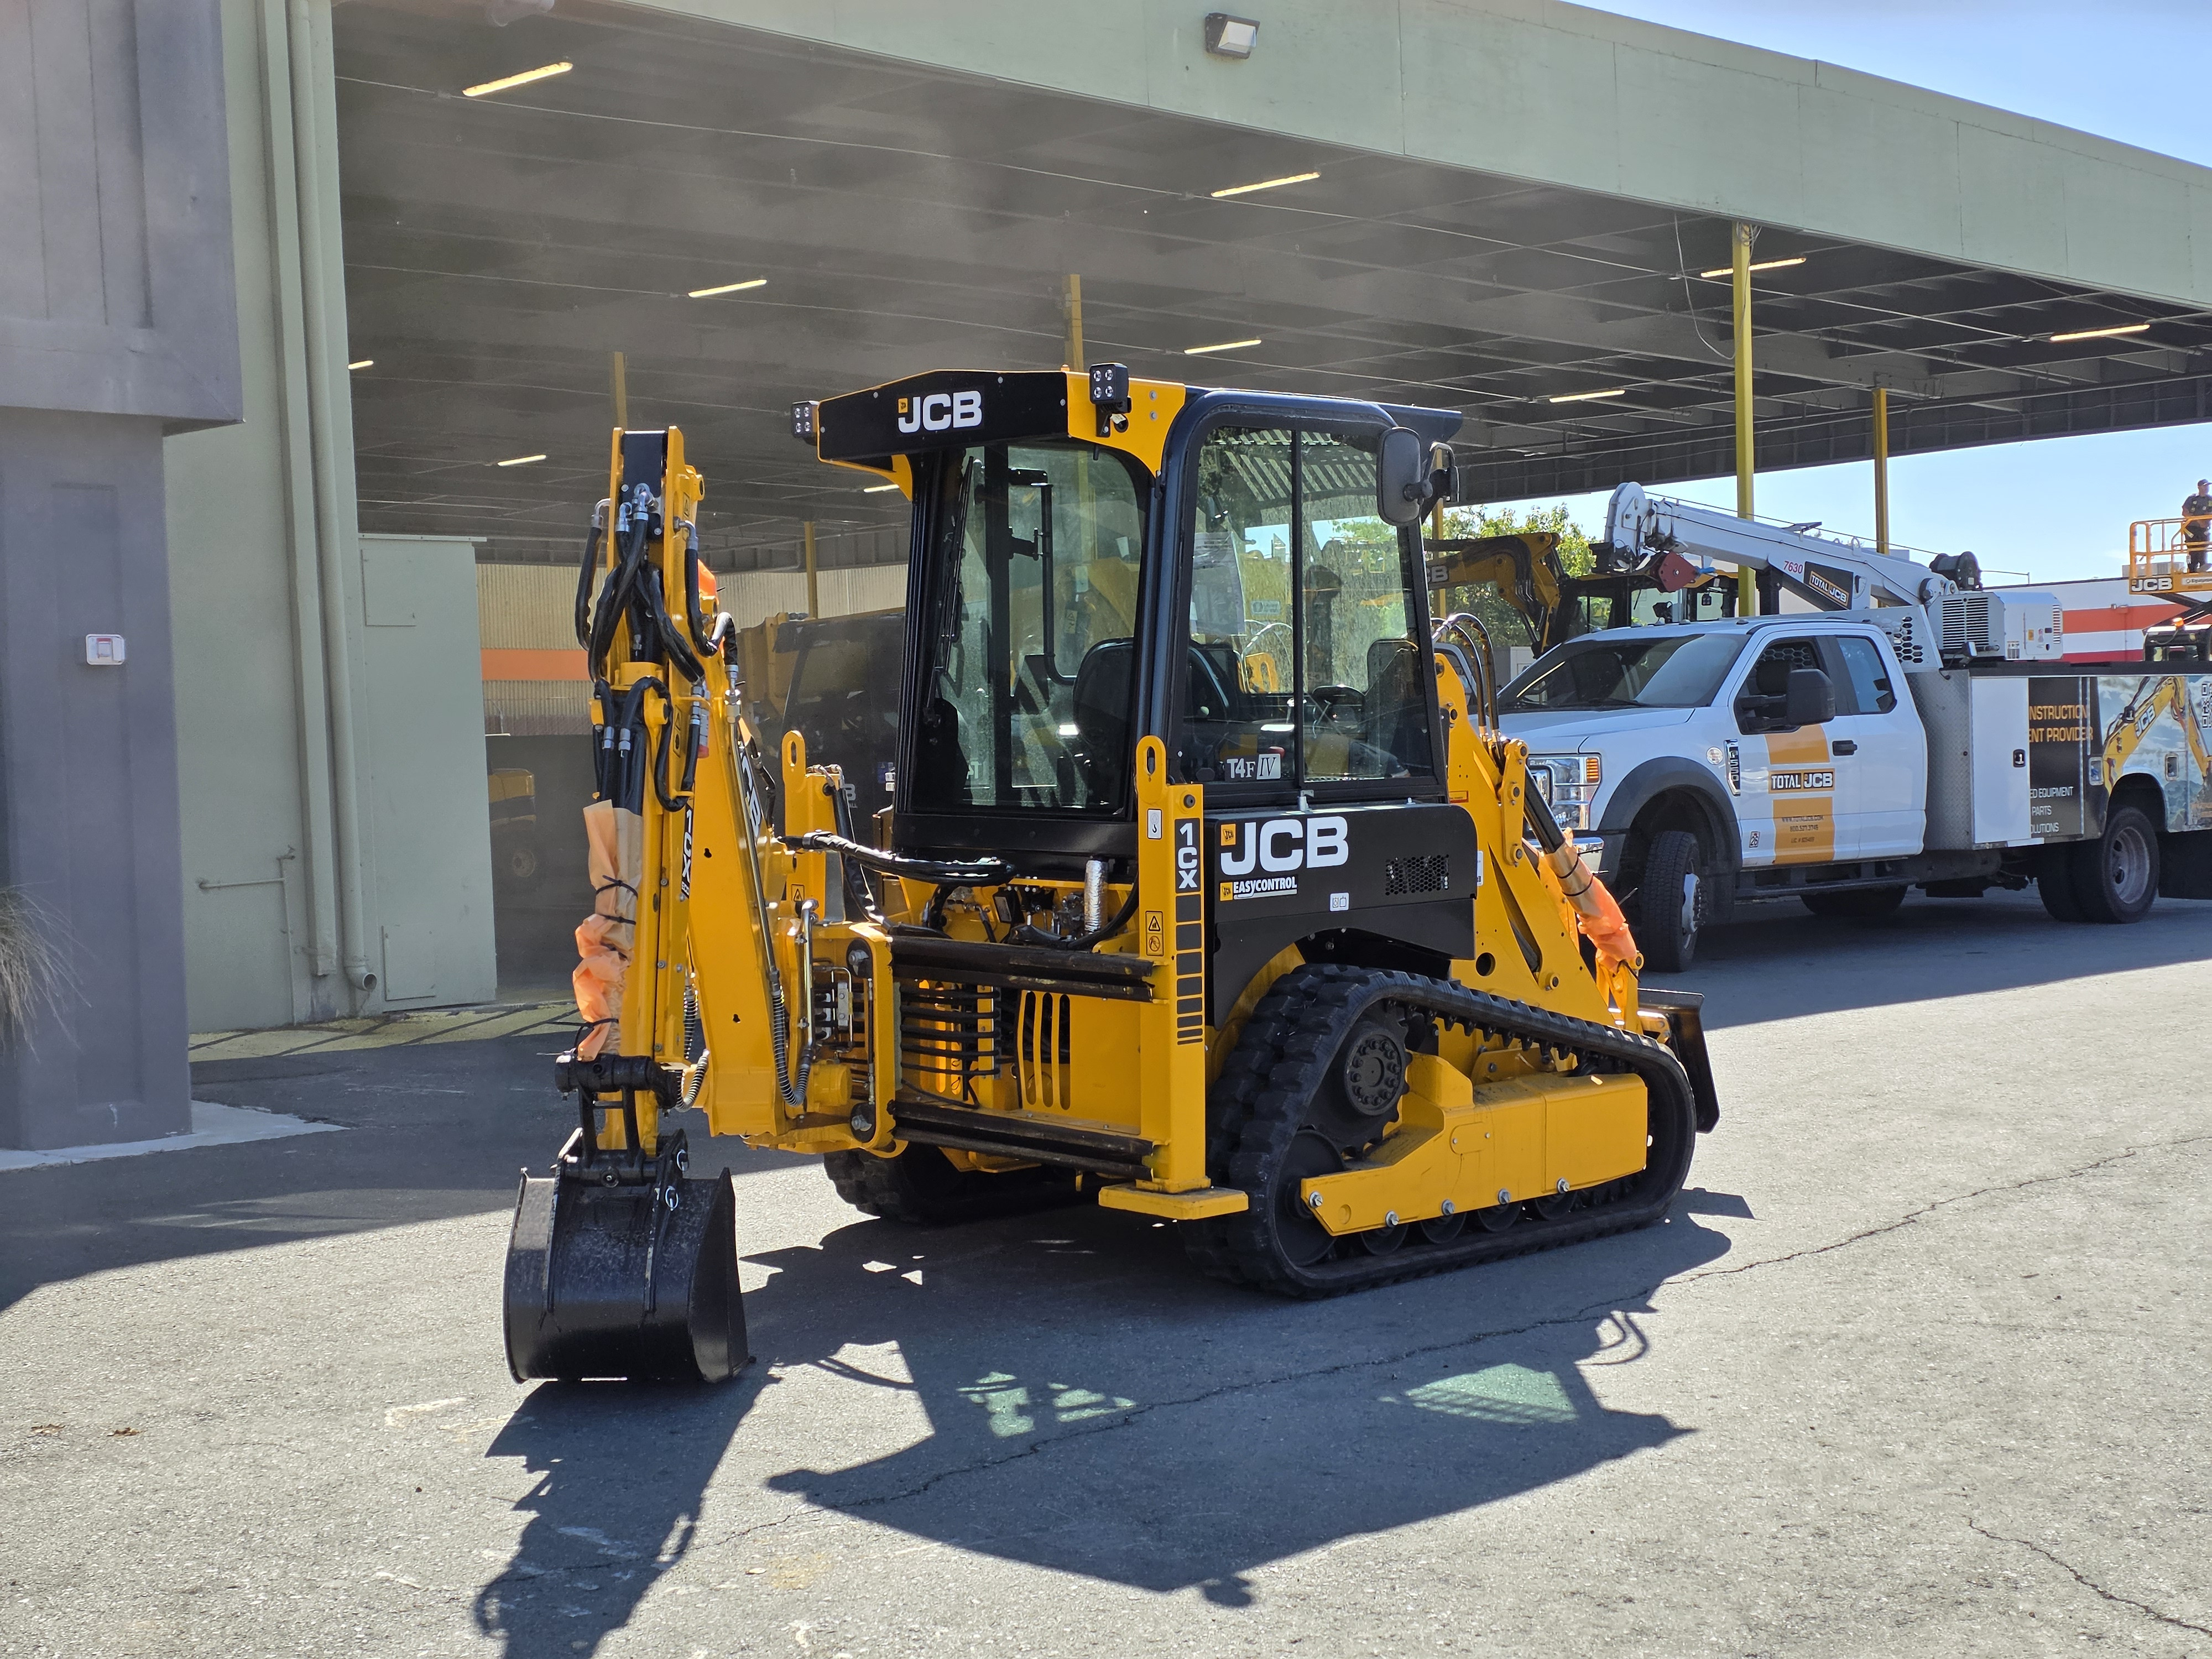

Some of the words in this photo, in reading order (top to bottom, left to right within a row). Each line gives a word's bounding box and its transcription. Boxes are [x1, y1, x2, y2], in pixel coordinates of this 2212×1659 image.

[898, 390, 982, 433] JCB
[1783, 560, 1803, 574] 7630
[1811, 575, 1828, 592] TOTAL
[1829, 587, 1847, 603] JCB
[2131, 577, 2173, 592] JCB
[2135, 704, 2156, 738] JCB
[2047, 726, 2093, 742] PROVIDER
[1771, 774, 1801, 790] TOTAL
[1804, 773, 1833, 788] JCB
[2038, 786, 2074, 798] EQUIPMENT
[2032, 805, 2052, 816] PARTS
[682, 809, 692, 884] 1CX
[1220, 816, 1349, 875] JCB
[1750, 836, 1759, 846] 26
[1178, 822, 1198, 889] 1CX
